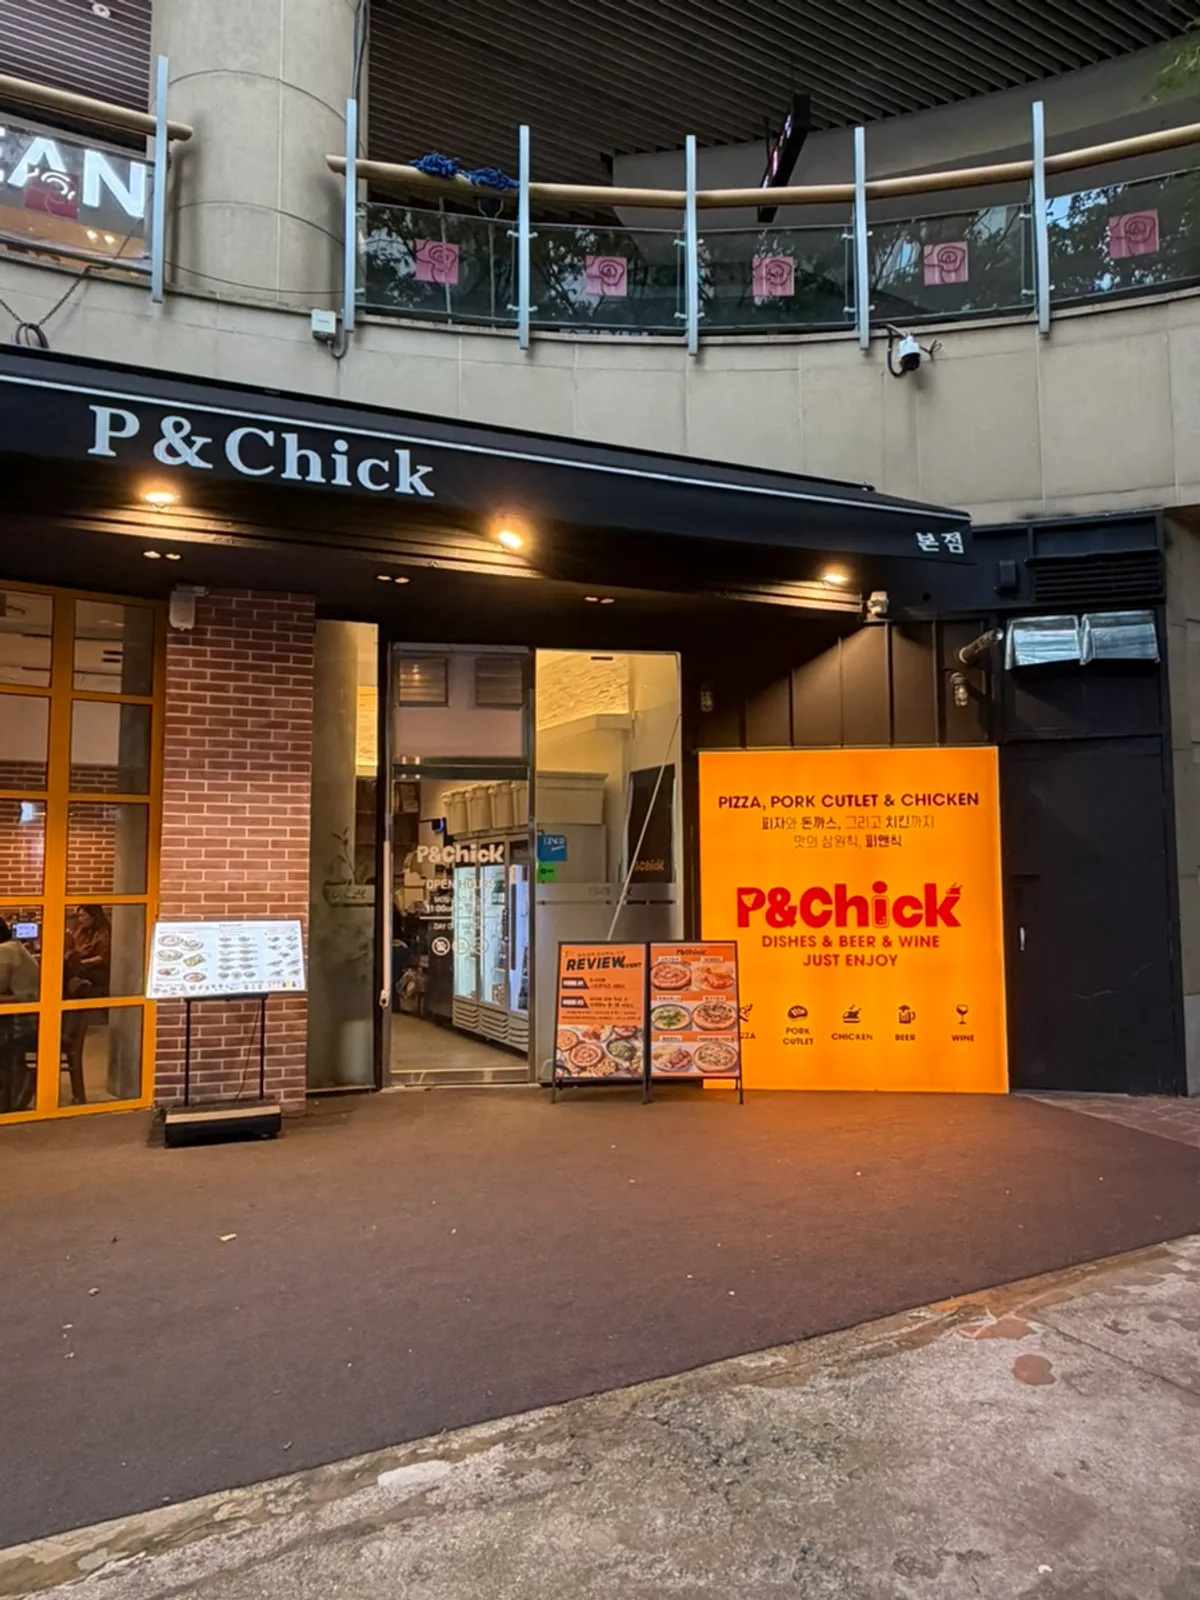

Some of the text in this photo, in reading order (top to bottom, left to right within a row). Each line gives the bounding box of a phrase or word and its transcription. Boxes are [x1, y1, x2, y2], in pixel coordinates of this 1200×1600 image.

[0, 127, 147, 218] AN
[915, 531, 965, 554] 본점
[718, 792, 979, 811] PIZZA, PORK CUTLET & CHICKEN
[761, 814, 935, 831] 피자와 돈까스, 그리고 치킨까지
[793, 834, 818, 849] 맛의
[417, 843, 504, 863] P&Chick
[426, 879, 455, 890] OPEN
[737, 880, 963, 928] P&Chick
[762, 934, 940, 948] DISHES & BEER & WINE
[566, 955, 626, 971] REVIEW
[803, 953, 898, 967] JUST ENJOY
[785, 1026, 811, 1035] PORK
[831, 1032, 873, 1041] CHICKEN
[894, 1033, 916, 1042] BEER
[951, 1033, 975, 1042] WINE
[782, 1037, 814, 1046] CUTLET
